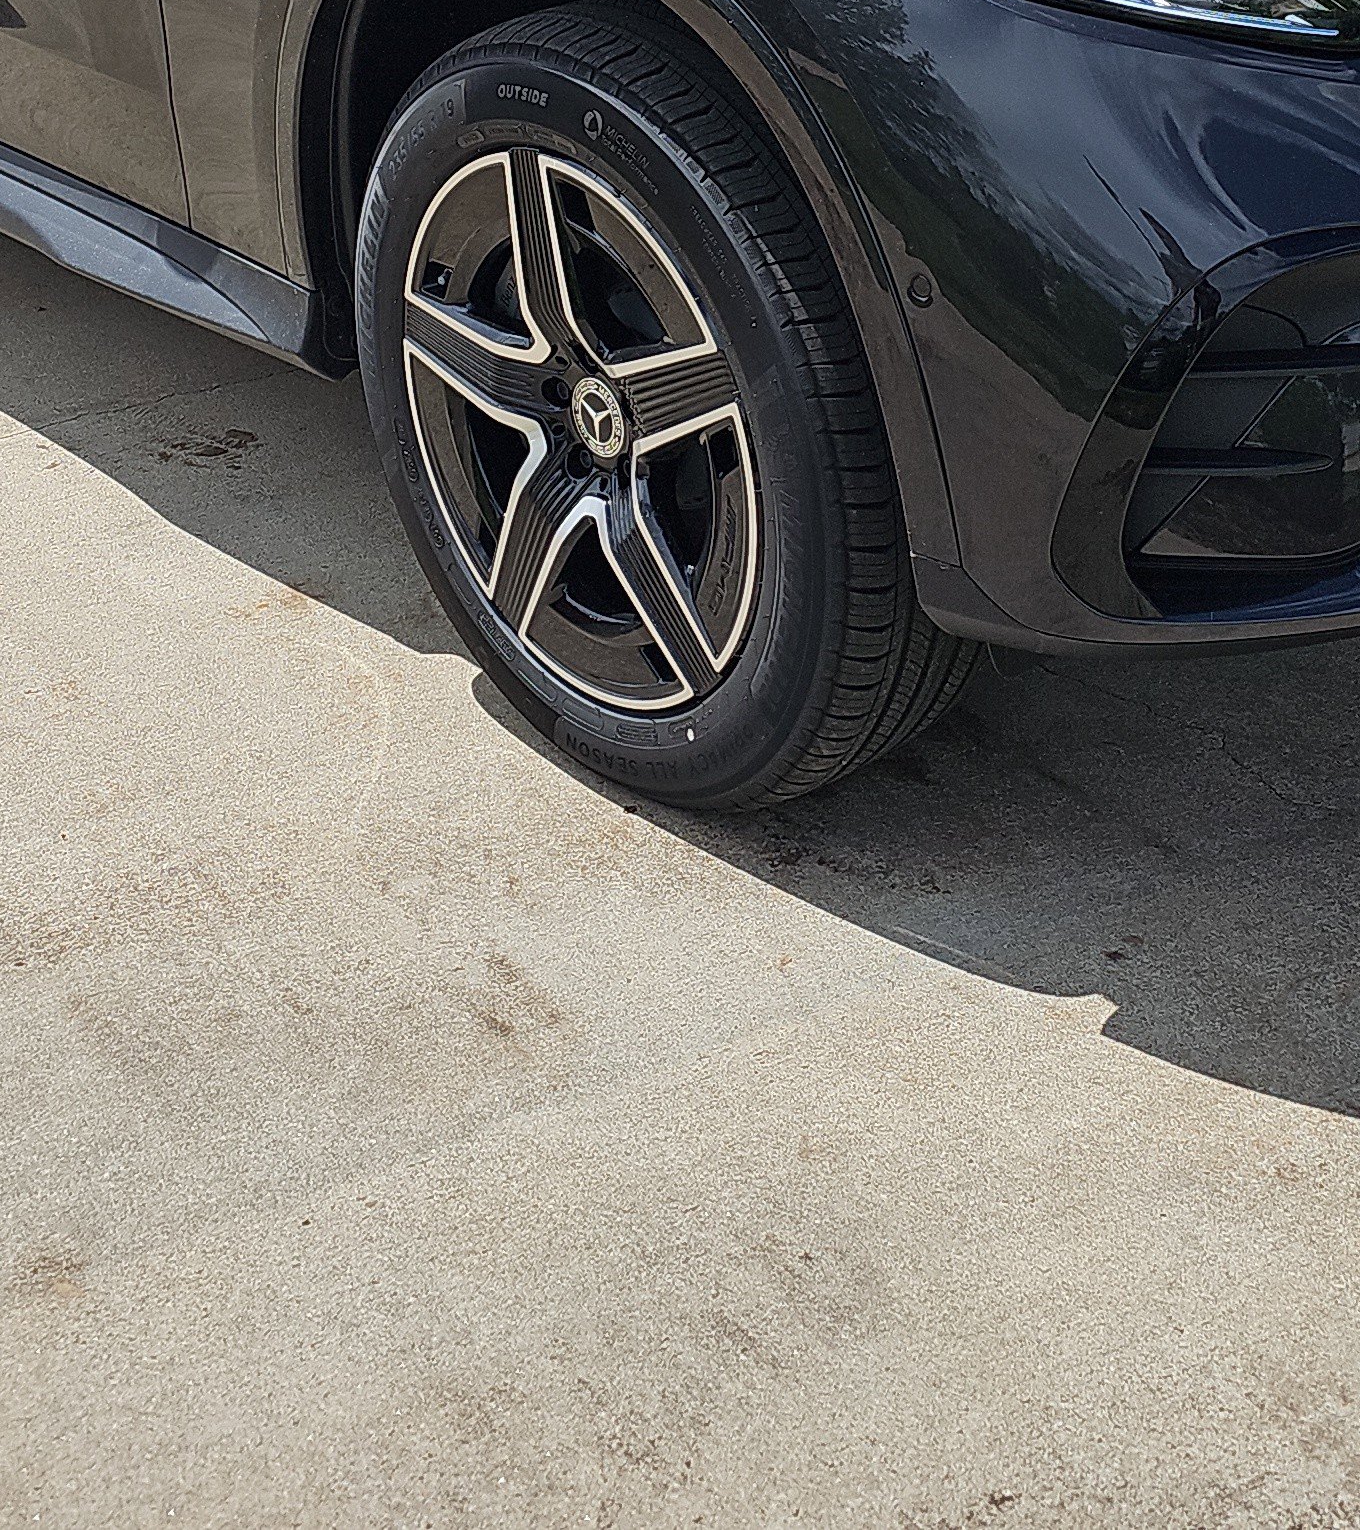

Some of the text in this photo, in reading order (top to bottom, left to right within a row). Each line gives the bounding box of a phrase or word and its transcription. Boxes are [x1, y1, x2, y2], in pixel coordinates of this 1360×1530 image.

[497, 83, 549, 108] OUTSIDE
[604, 125, 652, 170] MICHELIN
[565, 731, 639, 773] SEASON
